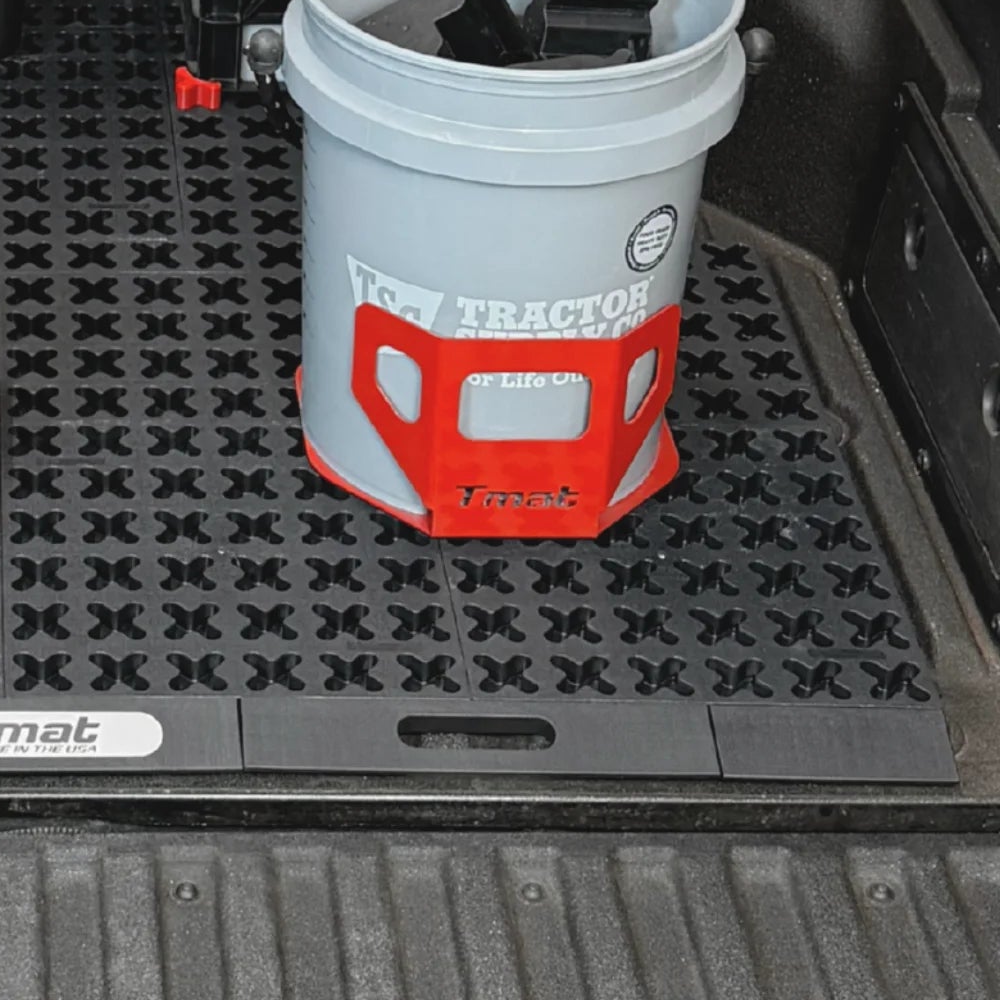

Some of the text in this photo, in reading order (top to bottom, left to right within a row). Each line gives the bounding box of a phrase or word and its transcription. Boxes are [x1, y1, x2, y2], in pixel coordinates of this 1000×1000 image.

[457, 280, 650, 330] TRACTOR
[501, 372, 546, 389] Life
[456, 485, 579, 508] Tmat
[13, 745, 30, 754] IN
[34, 745, 64, 754] THE
[65, 745, 97, 754] USA
